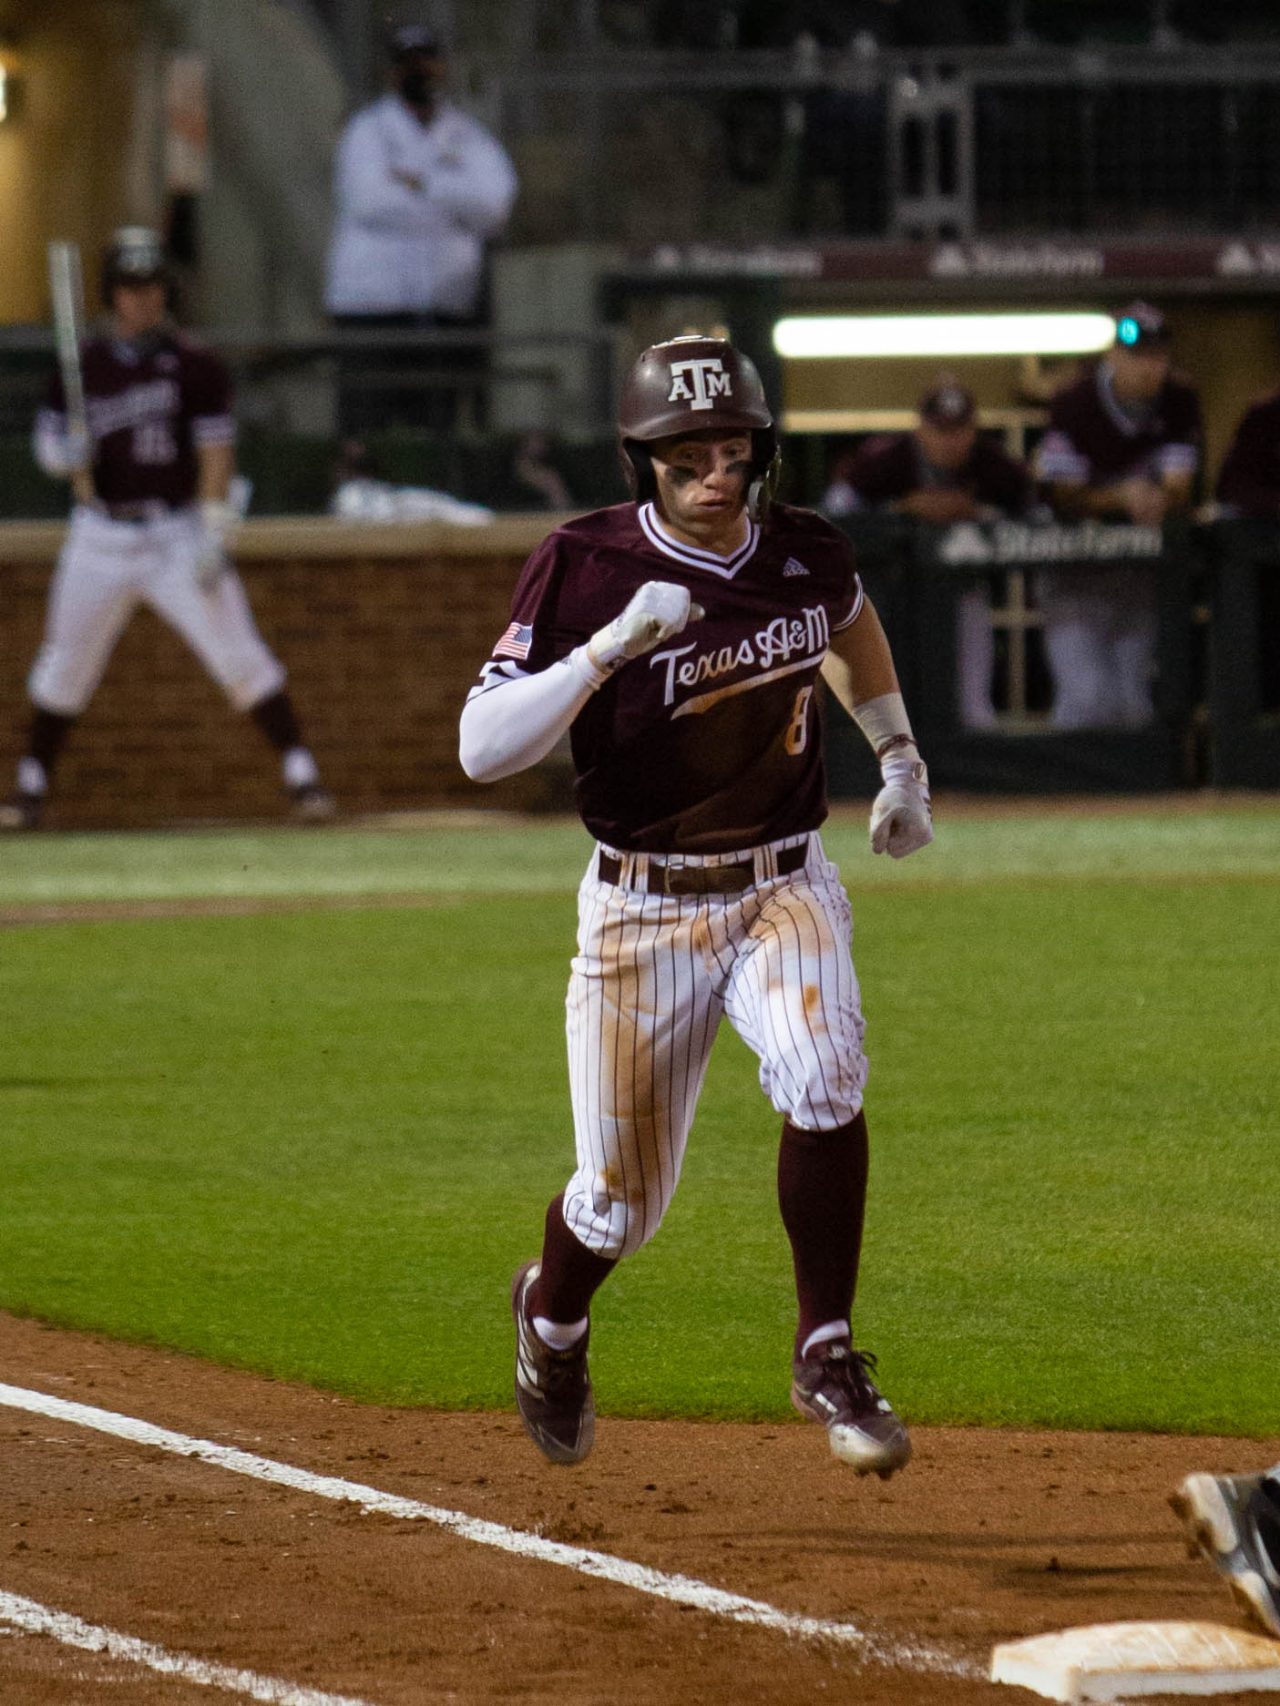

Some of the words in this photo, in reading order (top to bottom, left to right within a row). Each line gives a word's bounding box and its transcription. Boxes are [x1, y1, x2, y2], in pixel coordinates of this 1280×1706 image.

[650, 641, 755, 707] Texas
[756, 604, 829, 668] A&M
[785, 685, 813, 756] 8
